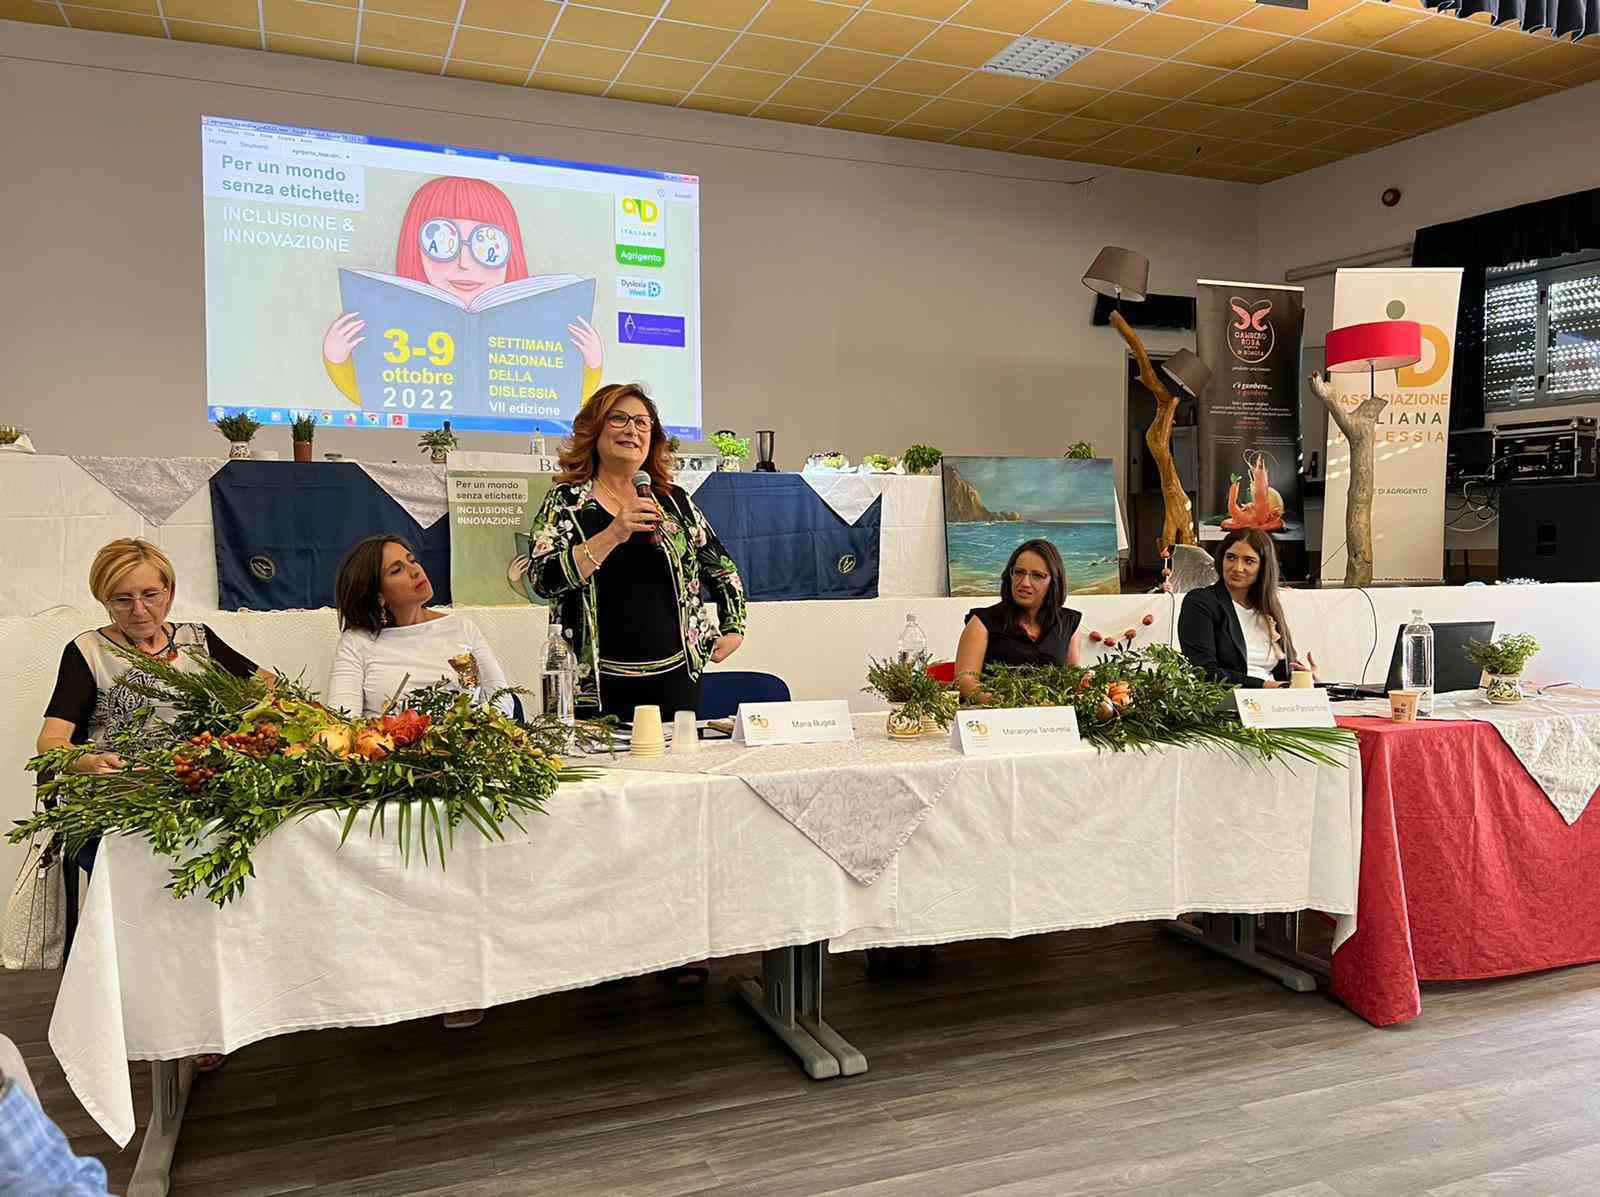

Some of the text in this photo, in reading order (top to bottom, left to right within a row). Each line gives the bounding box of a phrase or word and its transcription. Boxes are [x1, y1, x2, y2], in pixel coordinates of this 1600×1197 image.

[222, 154, 346, 181] Per un mondo
[222, 180, 359, 204] senza etichette:
[223, 206, 354, 232] INCLUSIONE &
[223, 227, 351, 253] INNOVAZIONE
[620, 249, 661, 264] Agrigento
[383, 328, 456, 366] 3-9
[488, 336, 564, 353] SETTIMANA
[488, 352, 564, 369] NAZIONALE
[382, 367, 455, 385] ottobre
[489, 369, 533, 383] DELLA
[383, 387, 454, 410] 2022
[489, 384, 558, 400] DISLESSIA
[1340, 393, 1449, 406] ASSCIAZIONE
[489, 401, 561, 417] VII edizione
[1375, 412, 1442, 425] LIANA
[456, 480, 471, 488] Per
[488, 480, 519, 489] mondo
[1386, 487, 1428, 495] AGRIGENTO
[484, 492, 526, 500] etichette:
[456, 505, 524, 514] INCLUSIONE &
[457, 516, 521, 525] INNOVAZIONE
